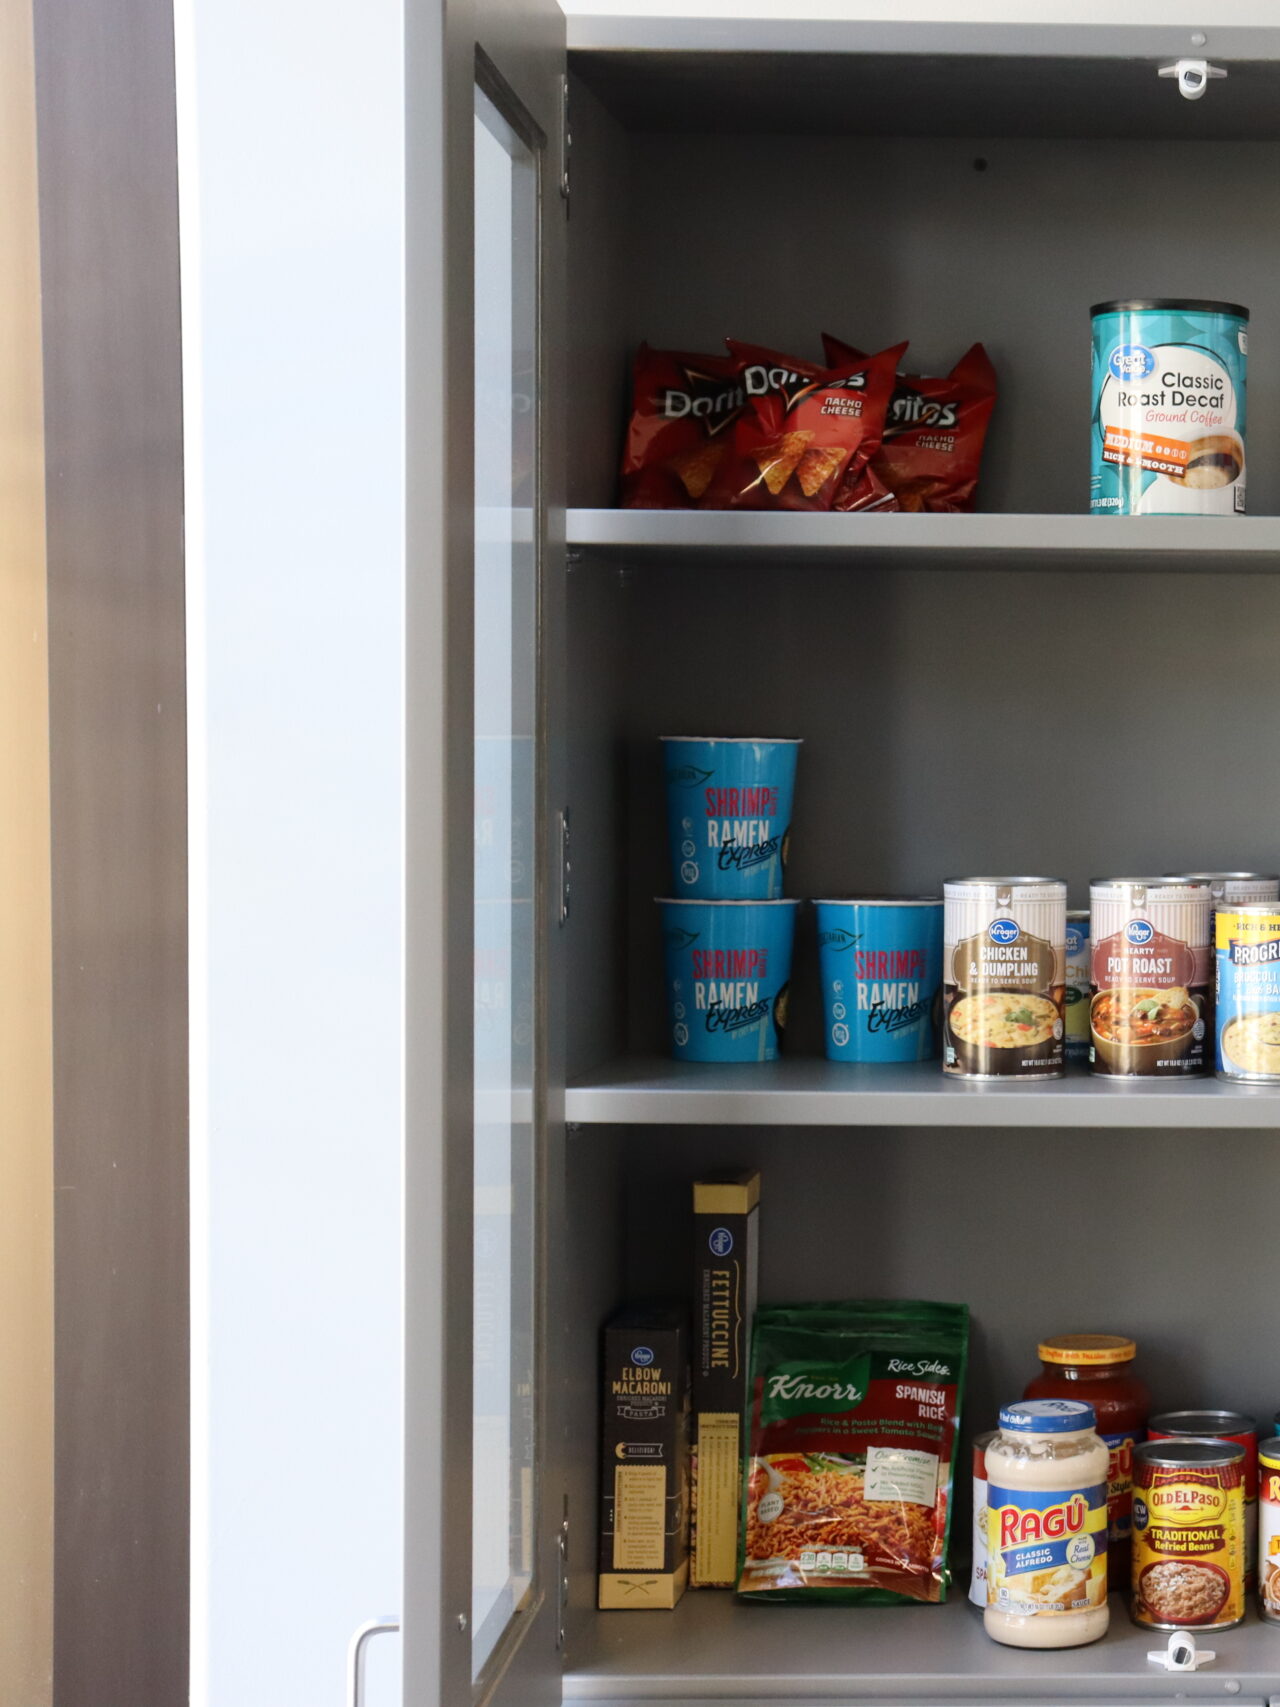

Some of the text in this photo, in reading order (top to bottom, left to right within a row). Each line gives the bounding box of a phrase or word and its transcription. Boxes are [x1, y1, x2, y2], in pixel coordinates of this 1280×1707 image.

[1162, 372, 1223, 390] Classic
[825, 397, 862, 409] NACHO
[1118, 391, 1224, 408] Roast Decaf
[820, 405, 862, 418] CHEESE
[1145, 409, 1223, 427] Ground Coffee
[705, 787, 768, 817] SHRIMP
[707, 820, 769, 847] RAMEN
[980, 947, 1028, 960] CHICKEN
[692, 949, 758, 978] SHRIMP
[854, 951, 918, 979] SHRIMP
[969, 963, 1038, 977] & DUMPLING
[1108, 958, 1172, 973] POT ROAST
[1234, 972, 1277, 983] BROCCOLI
[695, 982, 759, 1010] RAMEN
[857, 982, 919, 1010] RAMEN
[711, 1270, 730, 1368] FETTUCCINE
[622, 1368, 661, 1380] ELBOW
[612, 1382, 671, 1394] MACARONI
[768, 1374, 862, 1400] Knorr
[895, 1385, 945, 1405] SPANISH
[918, 1404, 945, 1420] RICE
[1152, 1493, 1172, 1506] OLD
[1174, 1491, 1190, 1504] EL
[1000, 1498, 1085, 1550] RAGÚ
[1151, 1529, 1220, 1540] TRADITIONAL
[1155, 1540, 1215, 1551] Refried Beans
[1015, 1548, 1051, 1561] CLASSIC
[1015, 1556, 1053, 1569] ALFREDO
